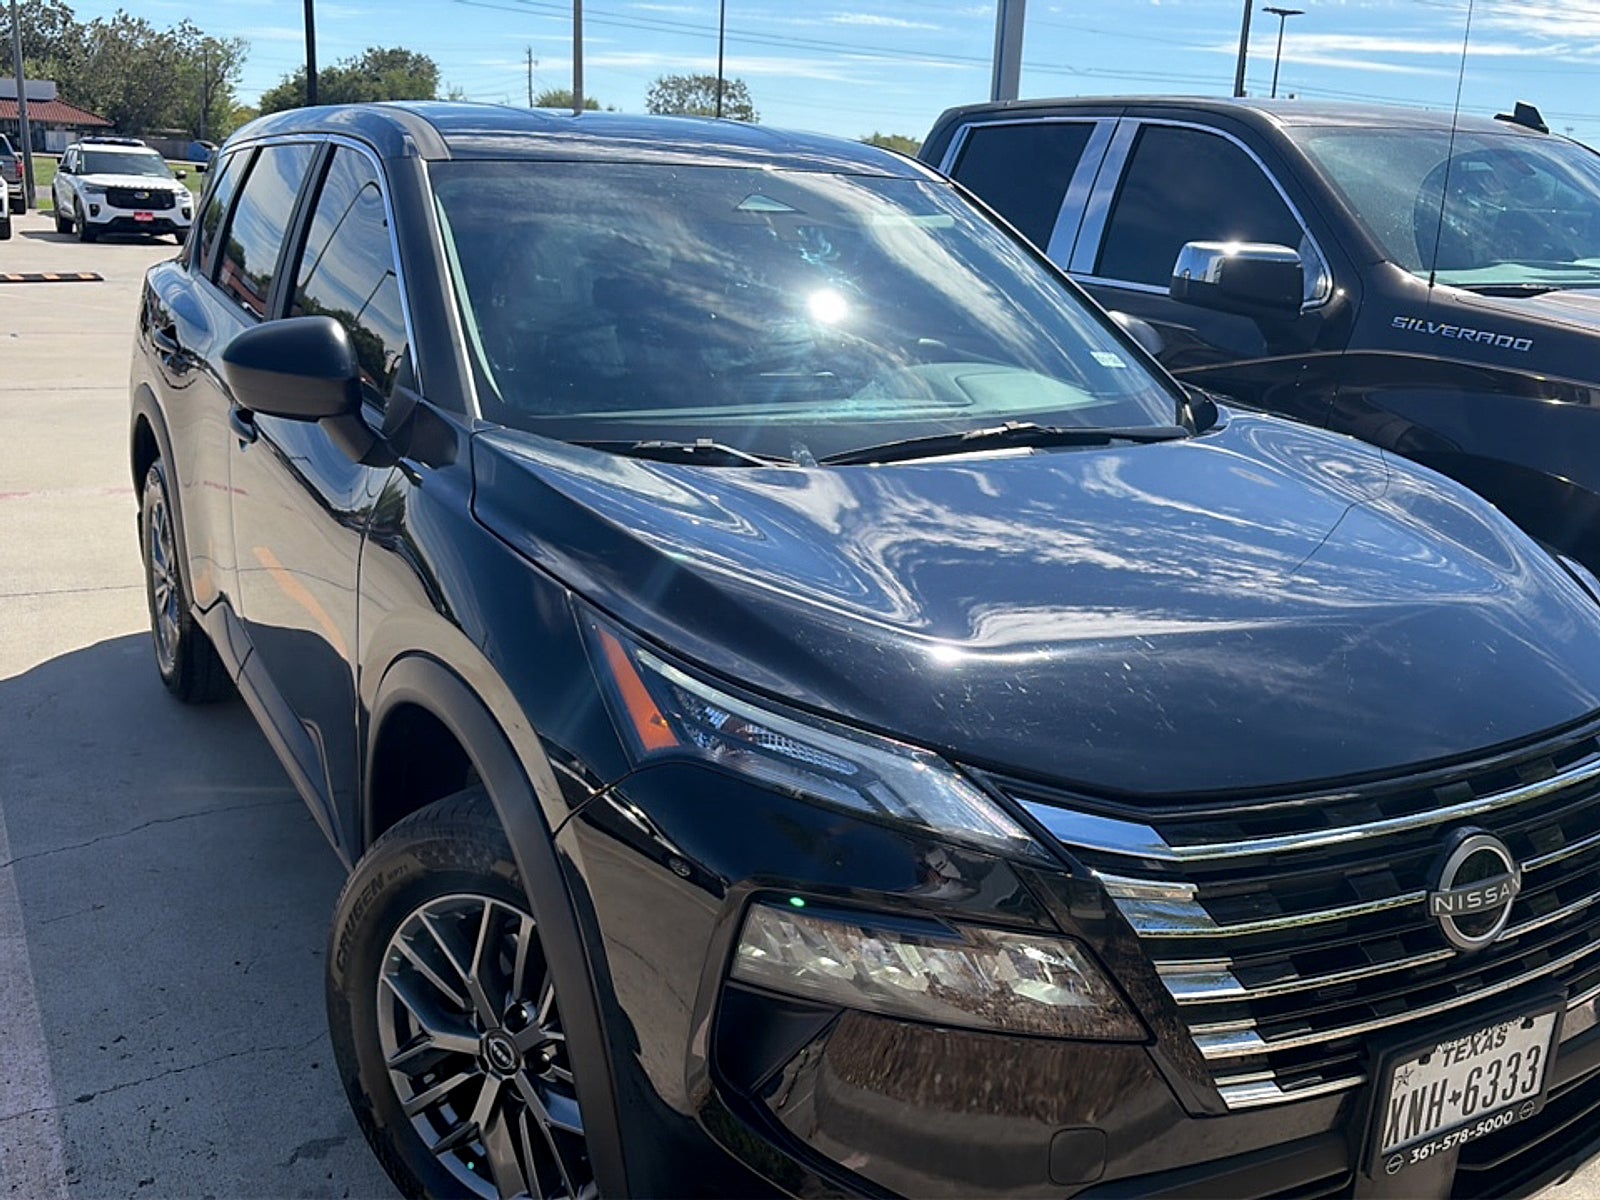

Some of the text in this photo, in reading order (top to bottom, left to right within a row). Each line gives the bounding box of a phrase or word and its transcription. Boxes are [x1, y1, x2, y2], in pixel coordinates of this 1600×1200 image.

[1391, 315, 1533, 352] SILVERADO
[1434, 876, 1520, 912] NISSAN
[335, 871, 385, 974] CRUGEN
[1442, 1028, 1507, 1067] TEXAS
[1461, 1044, 1541, 1116] 6333
[1409, 1110, 1514, 1164] 361-578-5000
